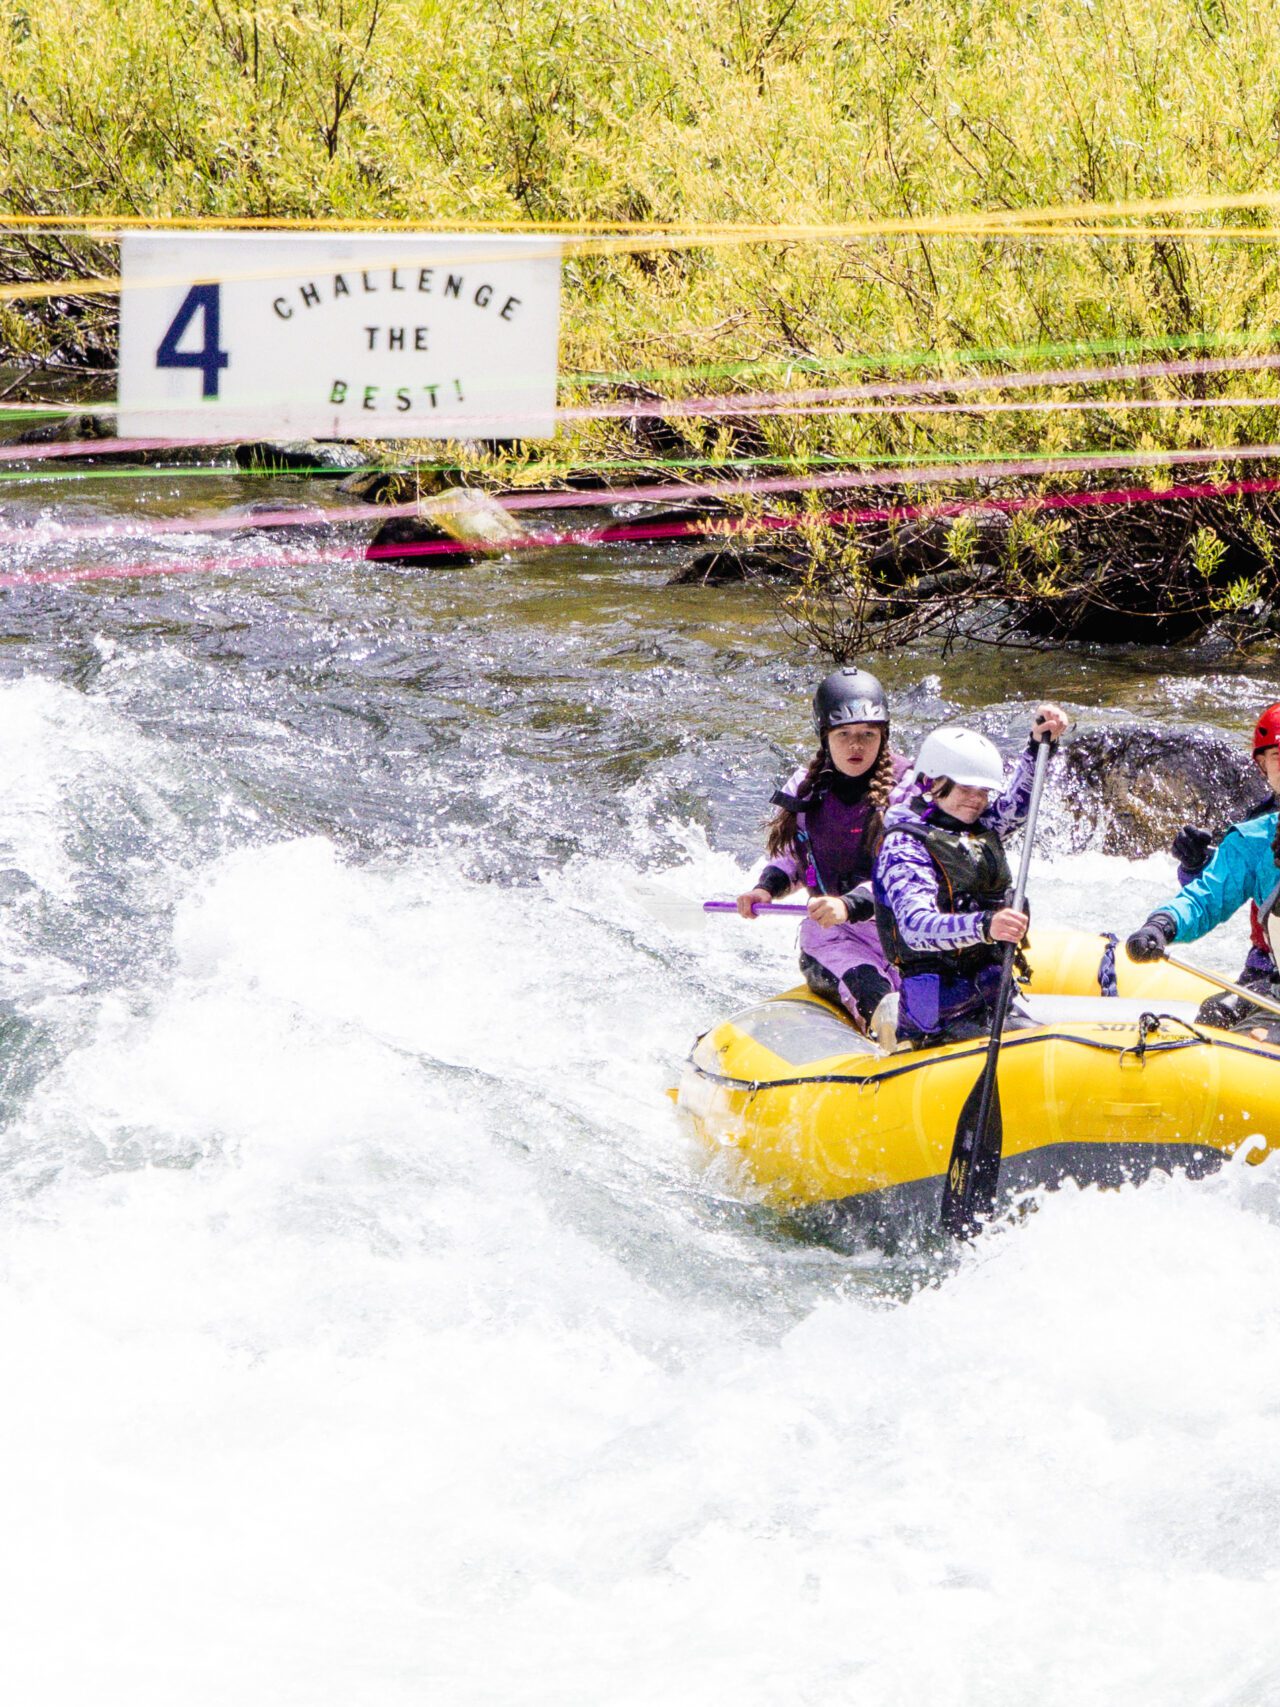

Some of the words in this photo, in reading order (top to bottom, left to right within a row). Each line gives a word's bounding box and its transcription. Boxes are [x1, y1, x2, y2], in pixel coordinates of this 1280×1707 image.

[272, 268, 522, 322] CHALLENGE
[155, 278, 229, 401] 4
[364, 326, 429, 351] THE
[329, 379, 465, 411] BEST!
